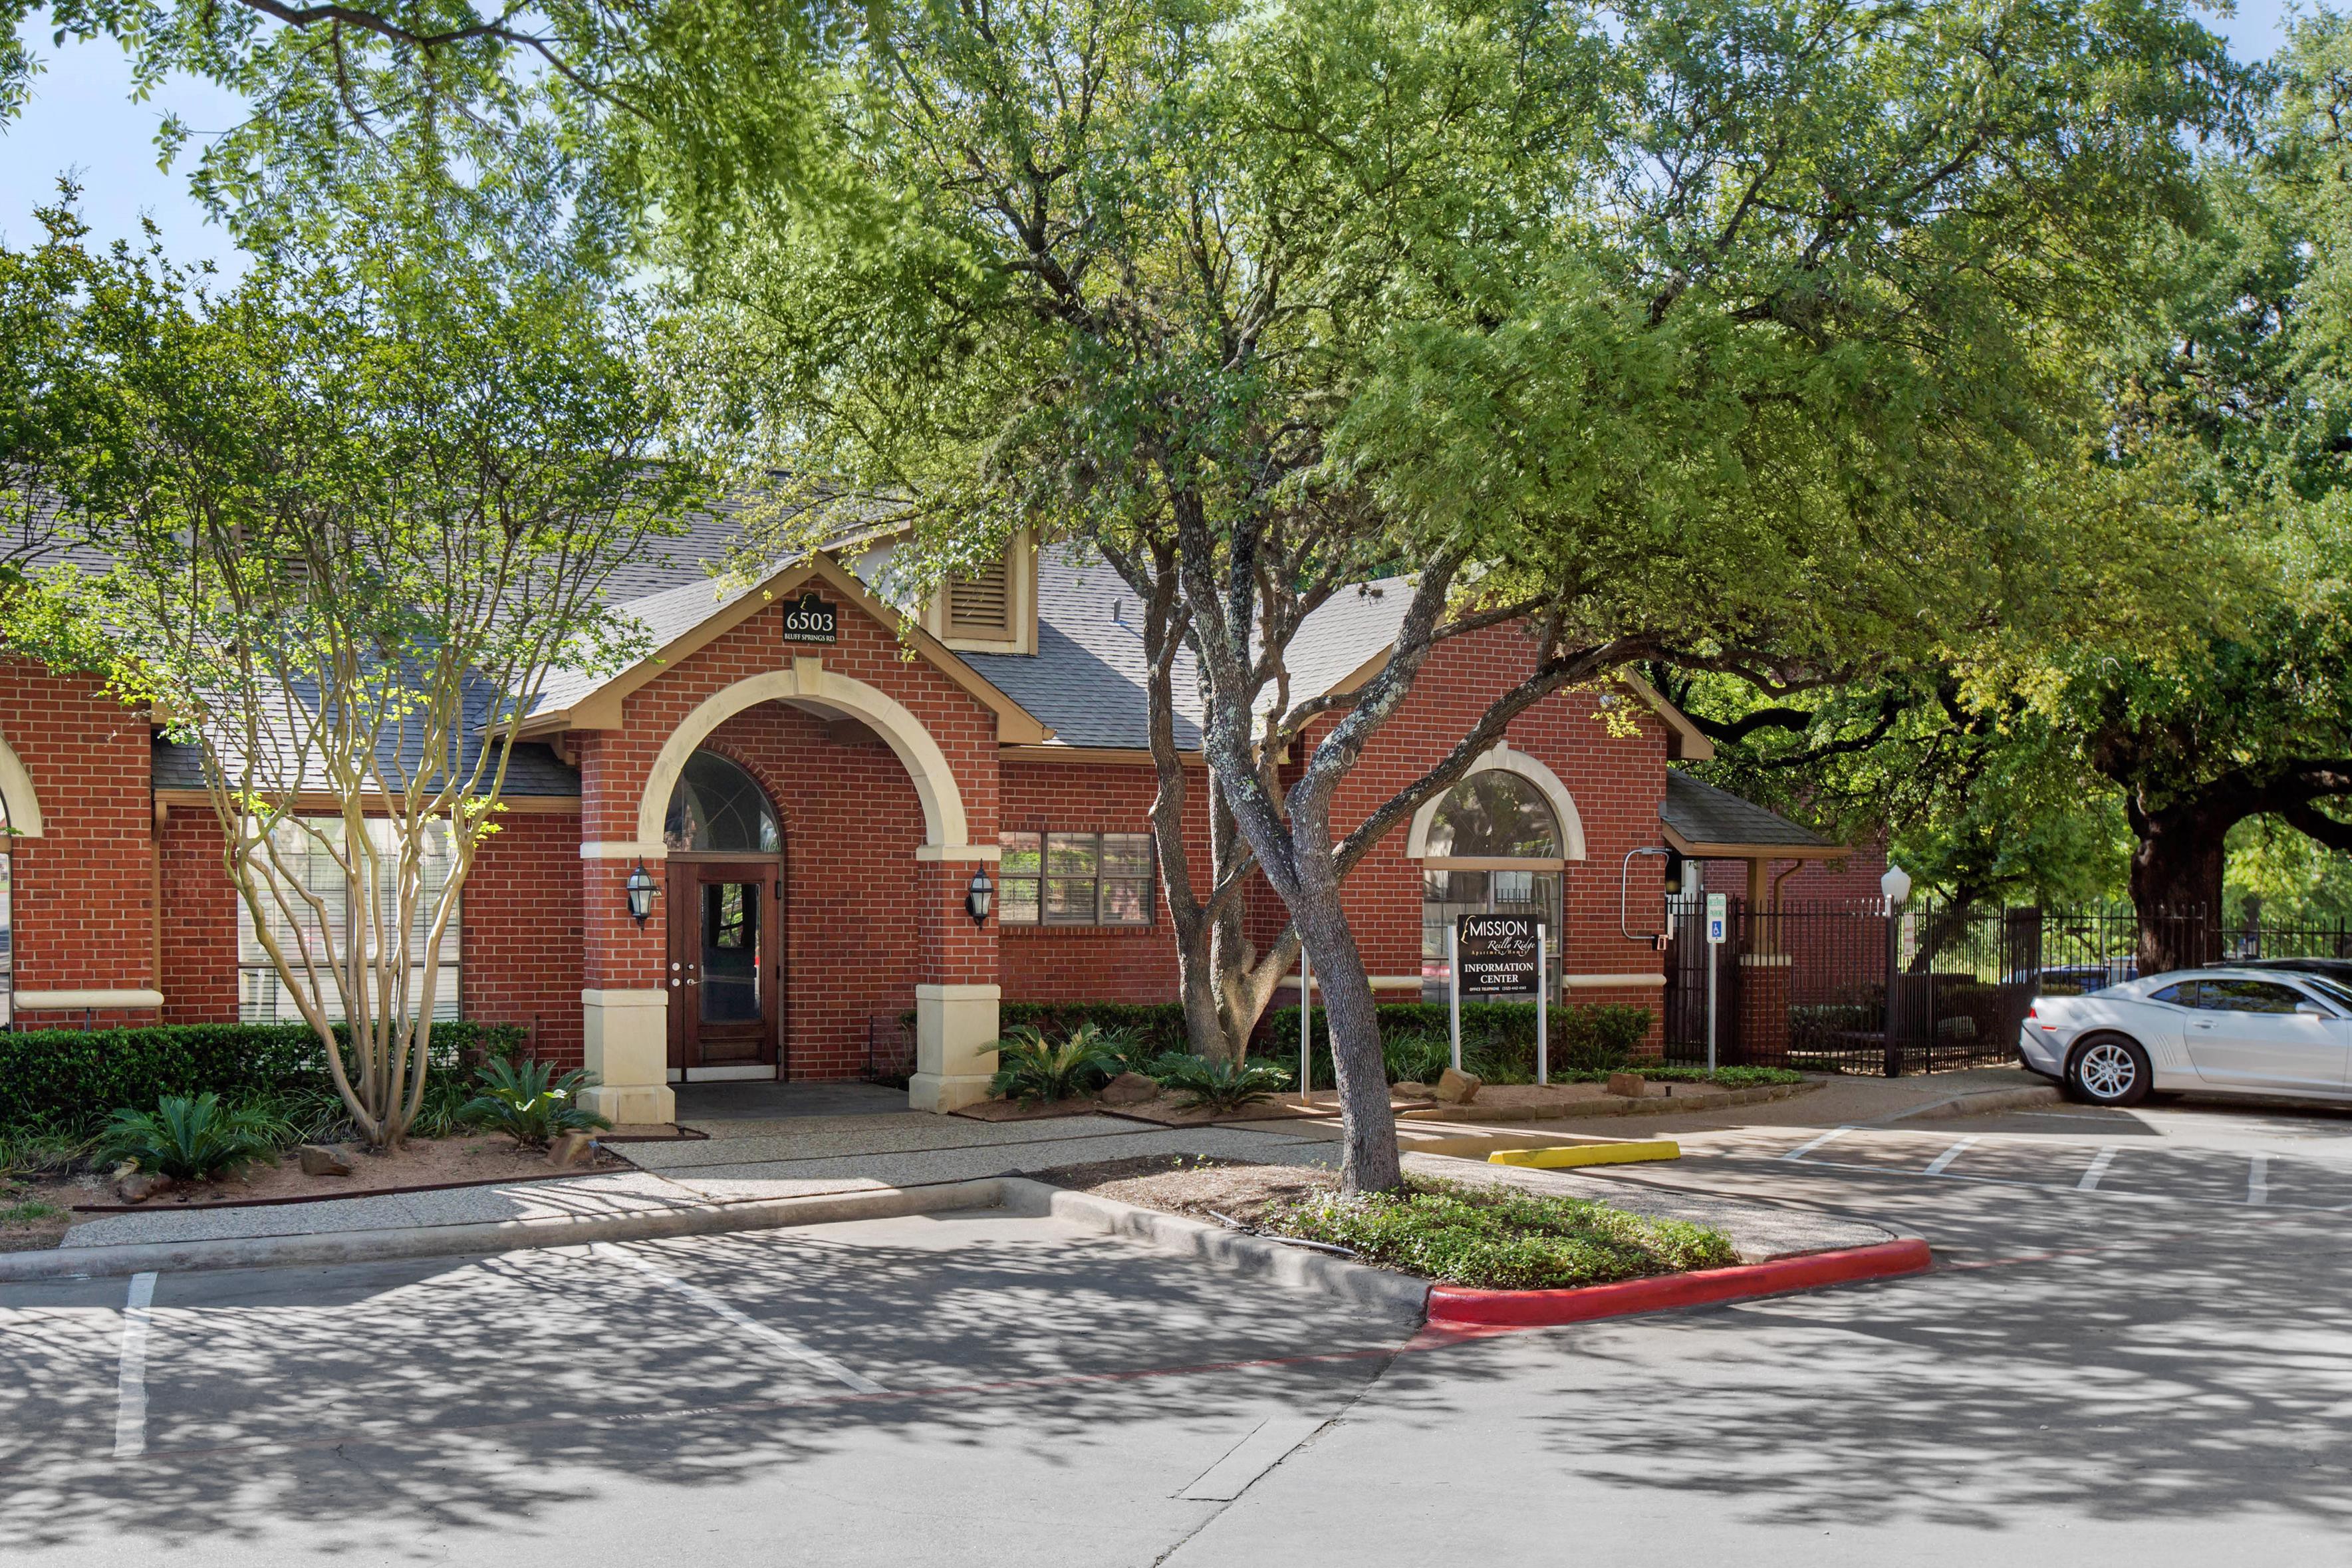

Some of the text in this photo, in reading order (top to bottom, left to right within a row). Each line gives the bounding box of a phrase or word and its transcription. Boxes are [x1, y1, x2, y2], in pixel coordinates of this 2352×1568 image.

[787, 612, 833, 631] 6503
[1470, 920, 1527, 936] MISSION
[1488, 936, 1536, 957] Reilly Ridge
[1464, 963, 1534, 973] INFORMATION
[1480, 974, 1519, 983] CENTER
[666, 1407, 723, 1416] LANE
